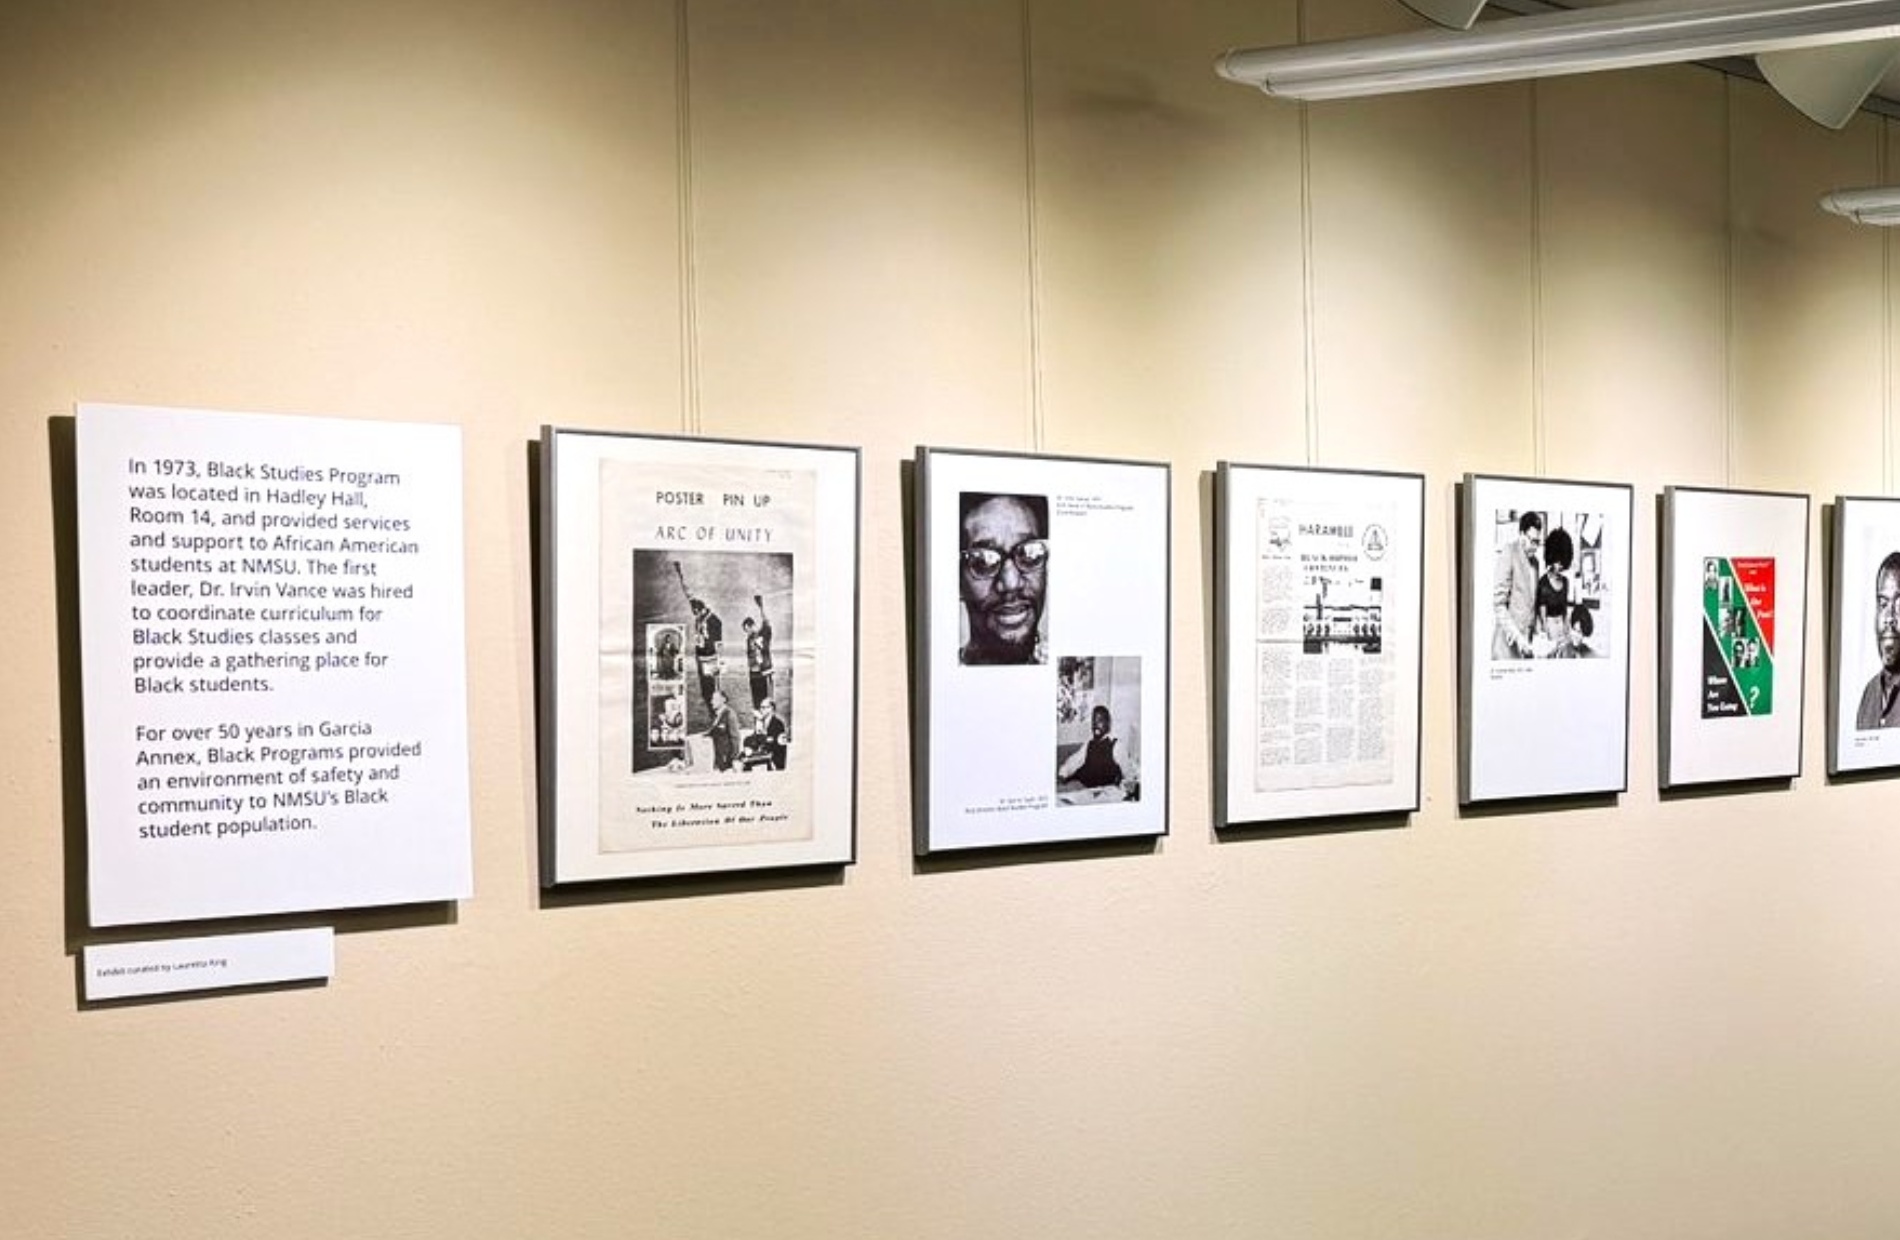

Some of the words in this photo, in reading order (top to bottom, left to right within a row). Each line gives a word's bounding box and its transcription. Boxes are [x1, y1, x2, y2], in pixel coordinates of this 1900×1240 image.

[129, 460, 146, 473] In
[155, 459, 200, 477] 1973,
[208, 461, 253, 478] Black
[261, 466, 322, 481] Studies
[330, 468, 400, 487] Program
[129, 487, 165, 499] was
[172, 484, 238, 501] located
[246, 490, 259, 502] in
[267, 489, 326, 509] Hadley
[332, 492, 367, 507] Hall,
[656, 491, 704, 506] POSTER
[723, 493, 744, 506] PIN
[753, 494, 771, 508] UP
[131, 507, 184, 523] Room
[192, 509, 214, 527] 14,
[222, 511, 255, 525] and
[263, 515, 337, 531] provided
[344, 518, 409, 530] services
[130, 532, 165, 547] and
[172, 537, 242, 553] support
[250, 537, 267, 550] to
[274, 535, 333, 551] African
[341, 538, 417, 552] American
[655, 526, 687, 540] ARC
[696, 526, 714, 540] OF
[725, 528, 773, 543] UNITY
[131, 557, 212, 572] students
[219, 560, 235, 572] at
[243, 559, 300, 574] NMSU.
[309, 560, 337, 574] The
[343, 560, 376, 575] first
[131, 581, 192, 598] leader,
[200, 581, 224, 596] Dr.
[231, 583, 270, 597] Irvin
[276, 583, 327, 598] Vance
[334, 587, 365, 598] was
[371, 584, 413, 598] hired
[132, 607, 151, 620] to
[157, 608, 255, 620] coordinate
[261, 607, 352, 620] curriculum
[360, 606, 381, 621] for
[133, 628, 182, 644] Black
[188, 630, 253, 644] Studies
[260, 630, 320, 644] classes
[326, 630, 357, 643] and
[134, 653, 204, 672] provide
[210, 656, 220, 667] a
[226, 653, 309, 672] gathering
[316, 653, 359, 670] place
[365, 652, 387, 665] for
[135, 677, 183, 693] Black
[190, 677, 272, 691] students.
[136, 726, 166, 741] For
[172, 728, 211, 740] over
[219, 724, 240, 739] 50
[246, 726, 292, 743] years
[299, 723, 313, 736] in
[319, 722, 372, 736] Garcia
[136, 751, 201, 765] Annex,
[208, 748, 254, 763] Black
[261, 747, 343, 765] Programs
[349, 743, 421, 762] provided
[137, 777, 160, 790] an
[167, 772, 283, 788] environment
[289, 768, 305, 784] of
[312, 767, 363, 785] safety
[369, 766, 398, 780] and
[138, 798, 243, 814] community
[250, 796, 266, 809] to
[273, 792, 338, 807] NMSU's
[345, 789, 387, 804] Black
[139, 820, 211, 838] student
[217, 817, 315, 838] population.
